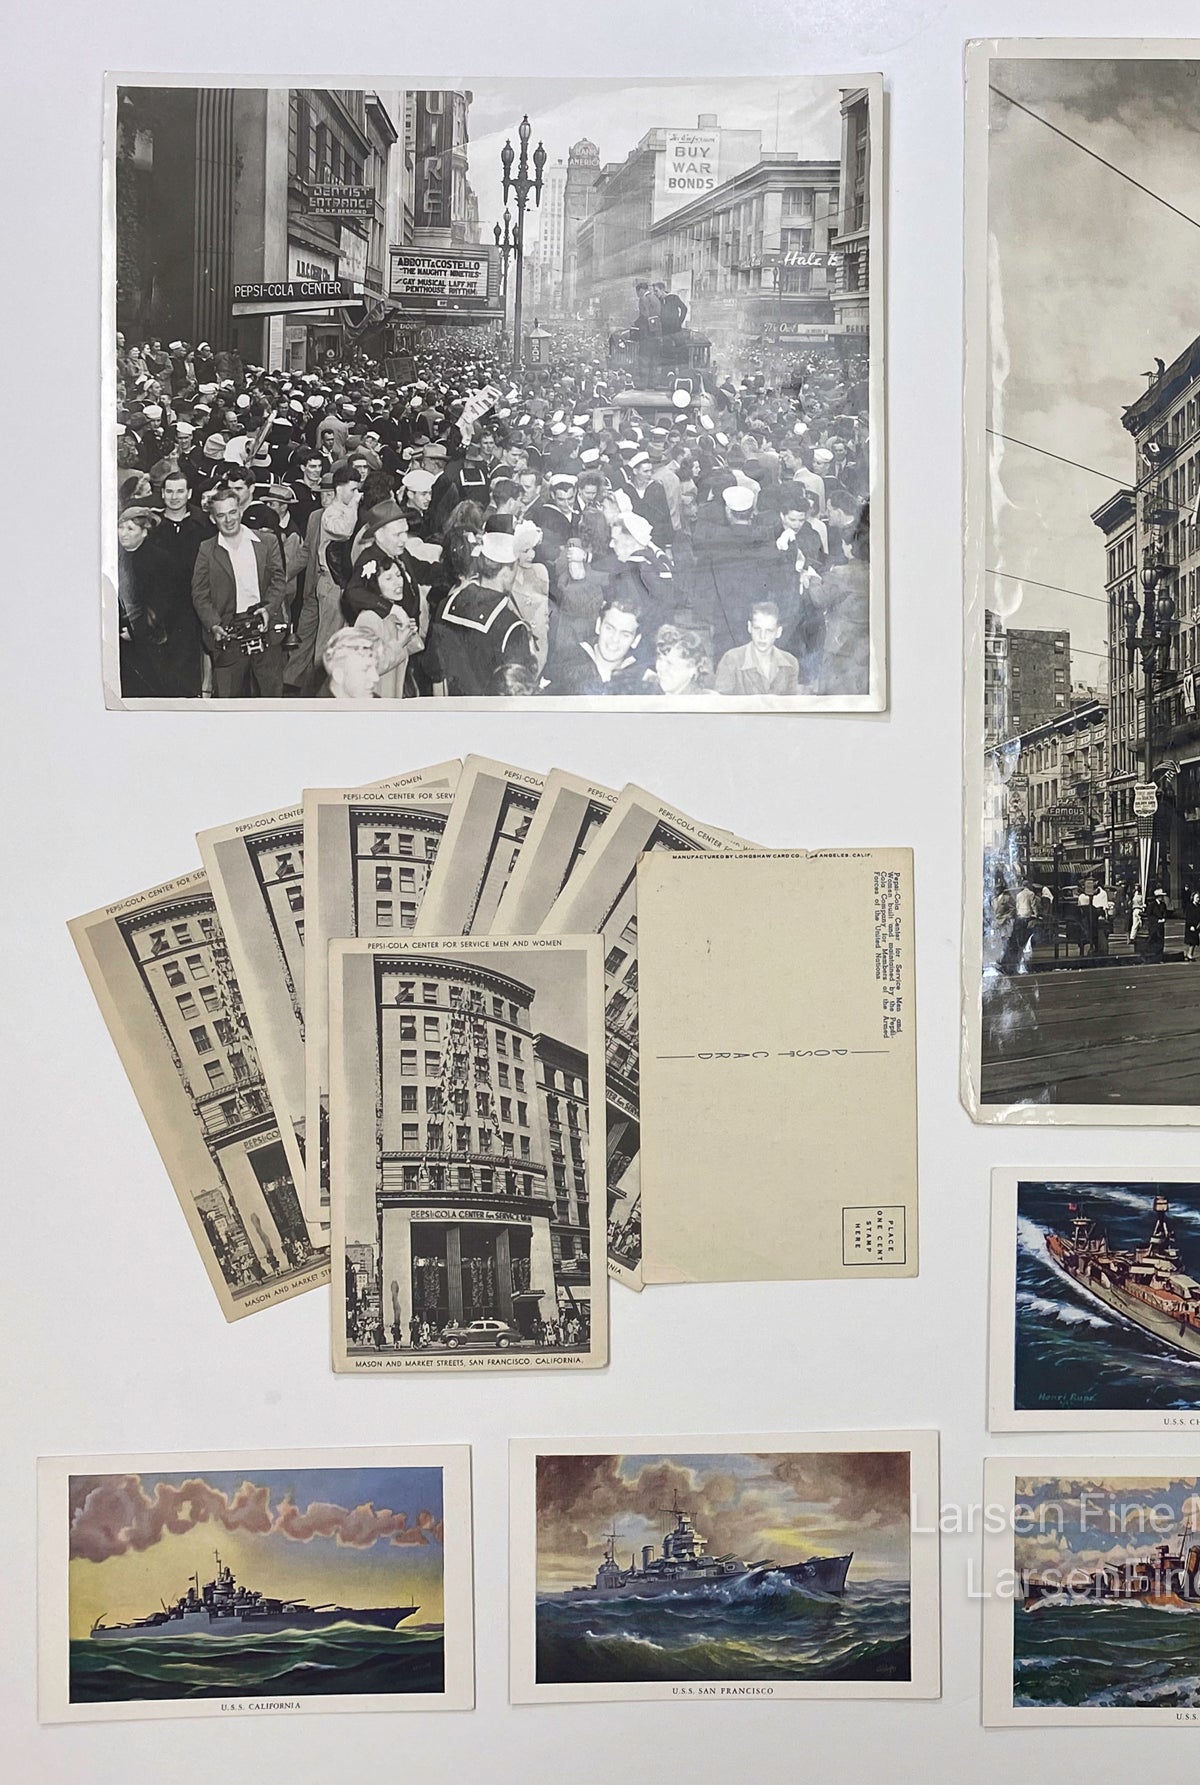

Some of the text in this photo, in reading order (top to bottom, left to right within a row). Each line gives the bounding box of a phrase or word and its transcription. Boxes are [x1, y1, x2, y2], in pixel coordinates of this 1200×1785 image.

[674, 146, 711, 158] BUY
[672, 162, 712, 174] WAR
[668, 177, 714, 190] BONDS
[313, 187, 370, 197] DENTIST
[309, 197, 373, 208] ENTRANCE
[784, 251, 822, 266] Hale
[234, 281, 342, 298] PEPSI-COLA CENTER
[393, 775, 422, 788] WOMEN
[504, 770, 544, 787] PEPSI-COLA
[1050, 807, 1084, 815] FAMOUS
[235, 817, 276, 832] PEPSI-COLA
[658, 807, 723, 848] PEPSI-COLA CENTER
[105, 877, 191, 915] PEPSI-COLA CENTER FOR
[880, 893, 888, 928] Company
[894, 917, 902, 941] Center
[882, 985, 889, 993] of
[889, 986, 895, 996] by
[698, 1049, 848, 1060] POST CARD
[410, 1210, 457, 1218] PEPSI-COLA
[458, 1210, 485, 1218] CENTER
[244, 1273, 319, 1308] MASON AND MARKET
[355, 1360, 383, 1368] MASON
[436, 1359, 466, 1367] STREETS,
[1163, 1418, 1186, 1426] U.S.S.
[672, 1687, 774, 1696] U.S.S. SAN FRANCISCO
[221, 1702, 301, 1711] U.S.S. CALIFORNIA
[1176, 1713, 1199, 1721] U.S.S.
